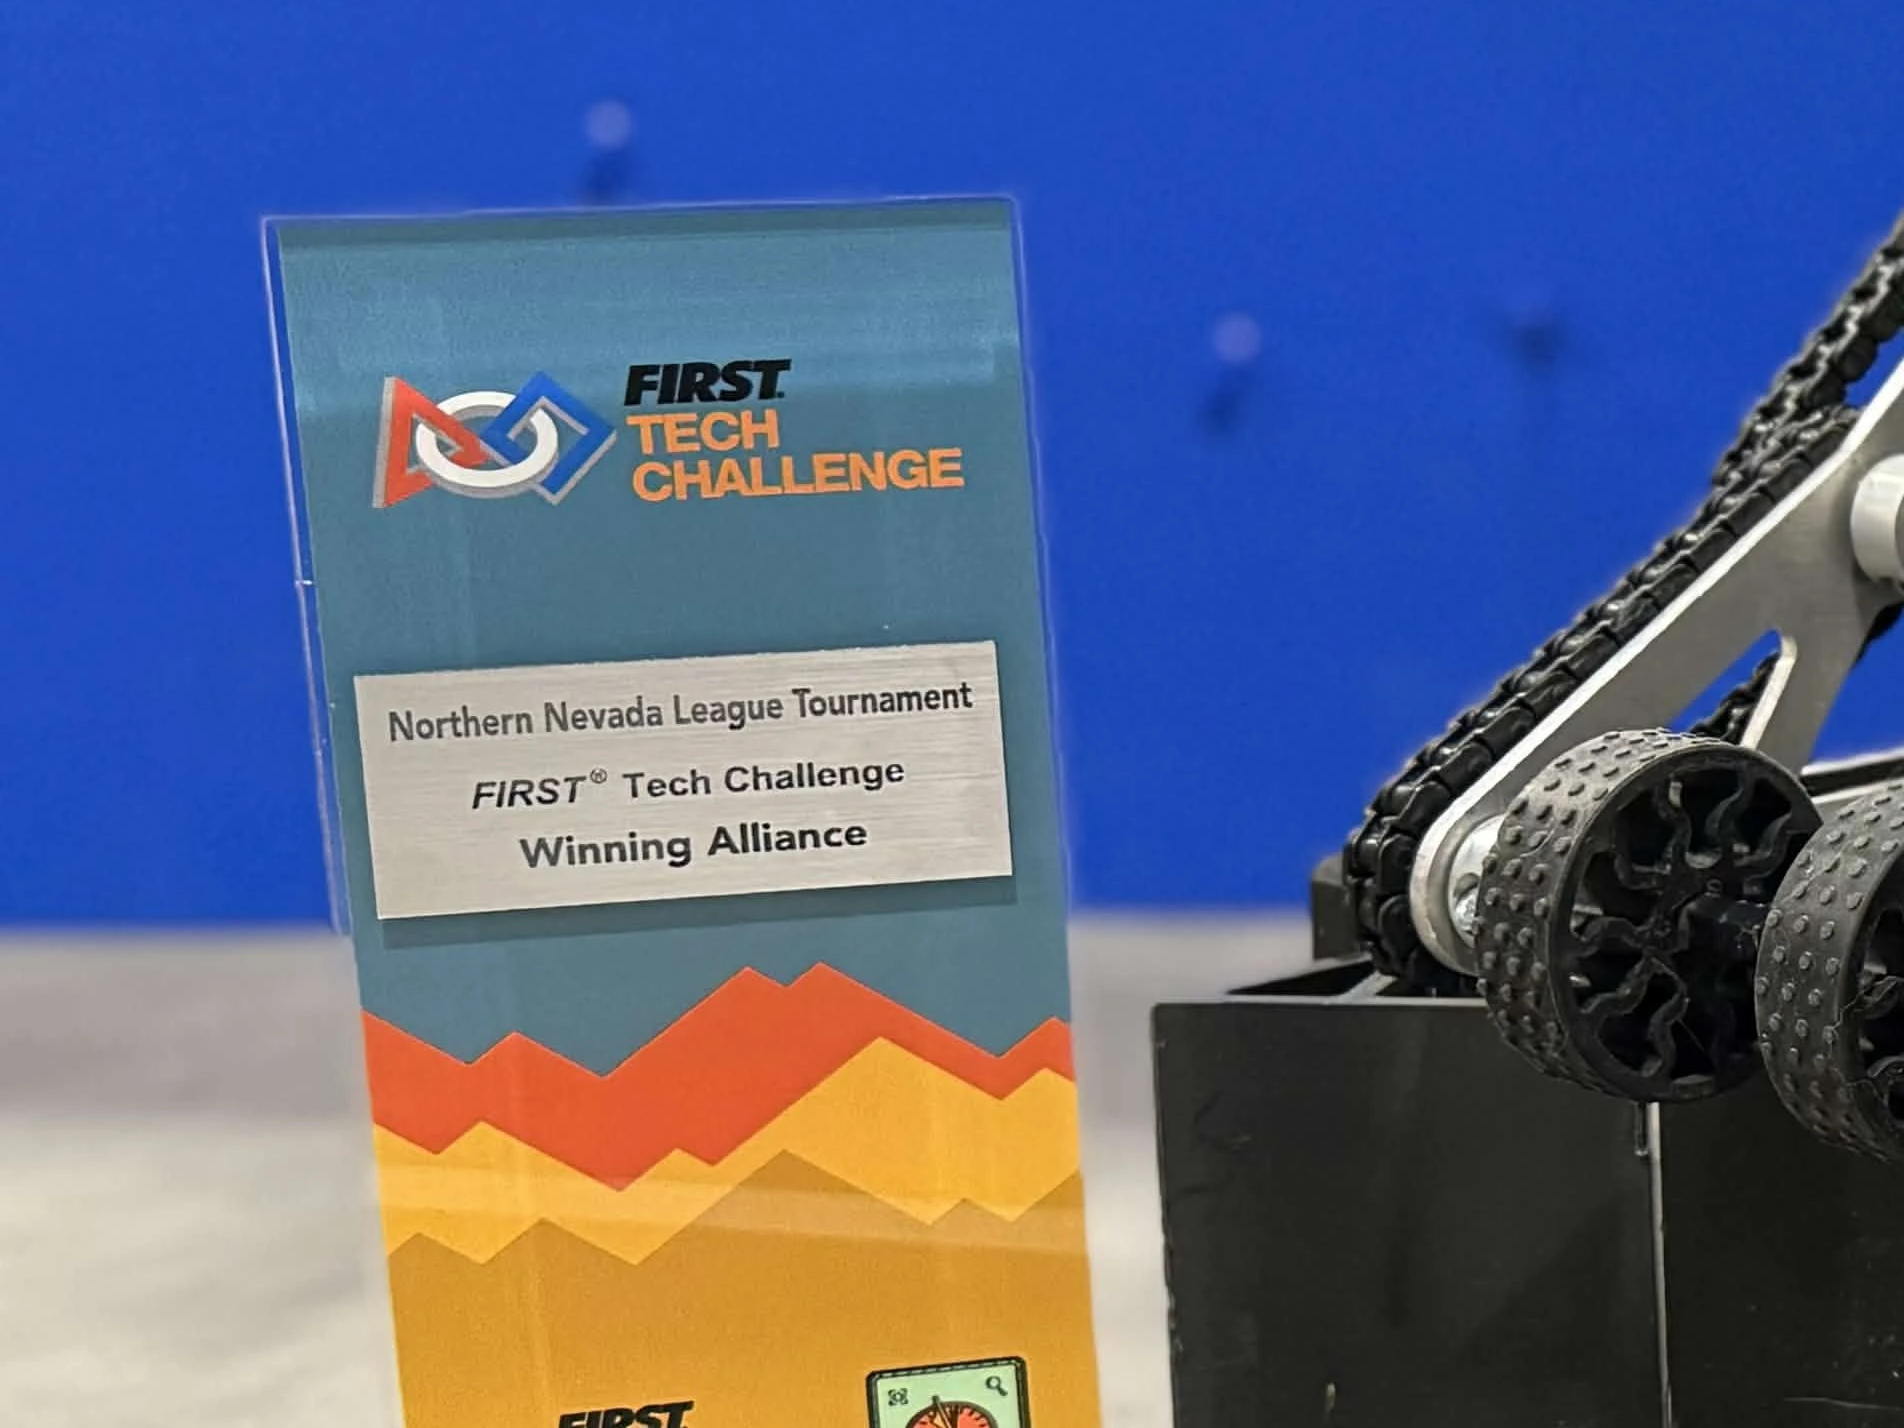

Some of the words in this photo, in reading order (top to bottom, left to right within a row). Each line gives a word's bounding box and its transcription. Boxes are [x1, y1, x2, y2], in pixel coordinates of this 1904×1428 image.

[624, 358, 791, 406] FIRST
[625, 409, 781, 455] TECH
[632, 447, 966, 502] CHALLENGE
[388, 705, 534, 742] Northern
[544, 695, 664, 733] Nevada
[673, 694, 785, 731] League
[792, 682, 973, 718] Tournament
[622, 769, 712, 799] Tech
[724, 762, 905, 793] Challenge
[519, 831, 692, 868] Winning
[708, 822, 868, 856] Alliance
